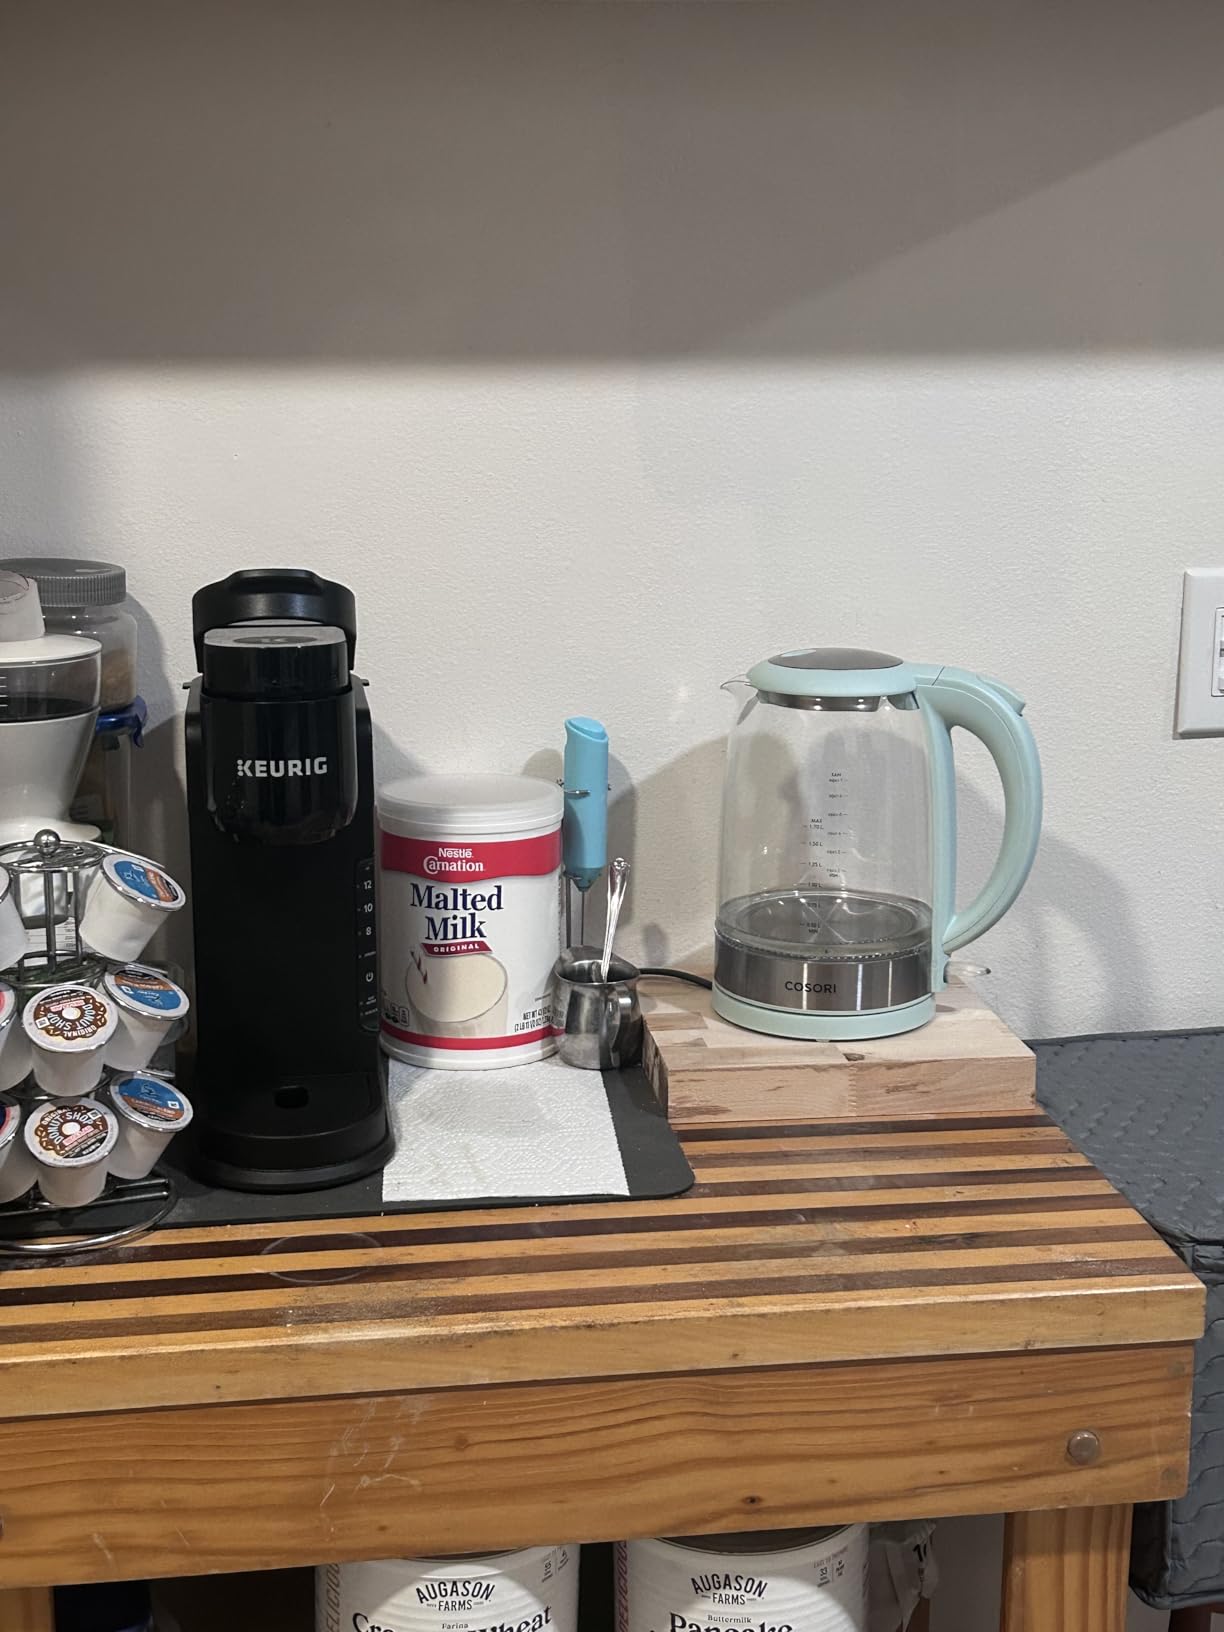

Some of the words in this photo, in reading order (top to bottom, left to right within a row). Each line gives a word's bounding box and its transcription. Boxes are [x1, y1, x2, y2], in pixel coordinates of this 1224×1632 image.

[237, 757, 328, 777] KEURIG
[423, 856, 484, 874] Carnation
[363, 880, 372, 890] 12
[410, 883, 504, 911] Malted
[363, 903, 373, 913] 10
[365, 926, 372, 936] 8
[425, 912, 487, 941] Milk
[433, 943, 480, 953] ORIGINAL
[784, 981, 837, 994] COSORI
[47, 1013, 71, 1030] SHOP
[76, 1004, 96, 1030] DONUT
[64, 1025, 97, 1038] ORIGINAL
[42, 1107, 71, 1126] ORIGINAL
[47, 1115, 65, 1144] DONUT
[66, 1111, 95, 1125] SHOP
[416, 1580, 495, 1604] AUGASON
[690, 1573, 768, 1598] AUGASON
[438, 1599, 473, 1611] FARMS
[712, 1592, 746, 1605] FARMS
[707, 1614, 752, 1624] Buttermilk
